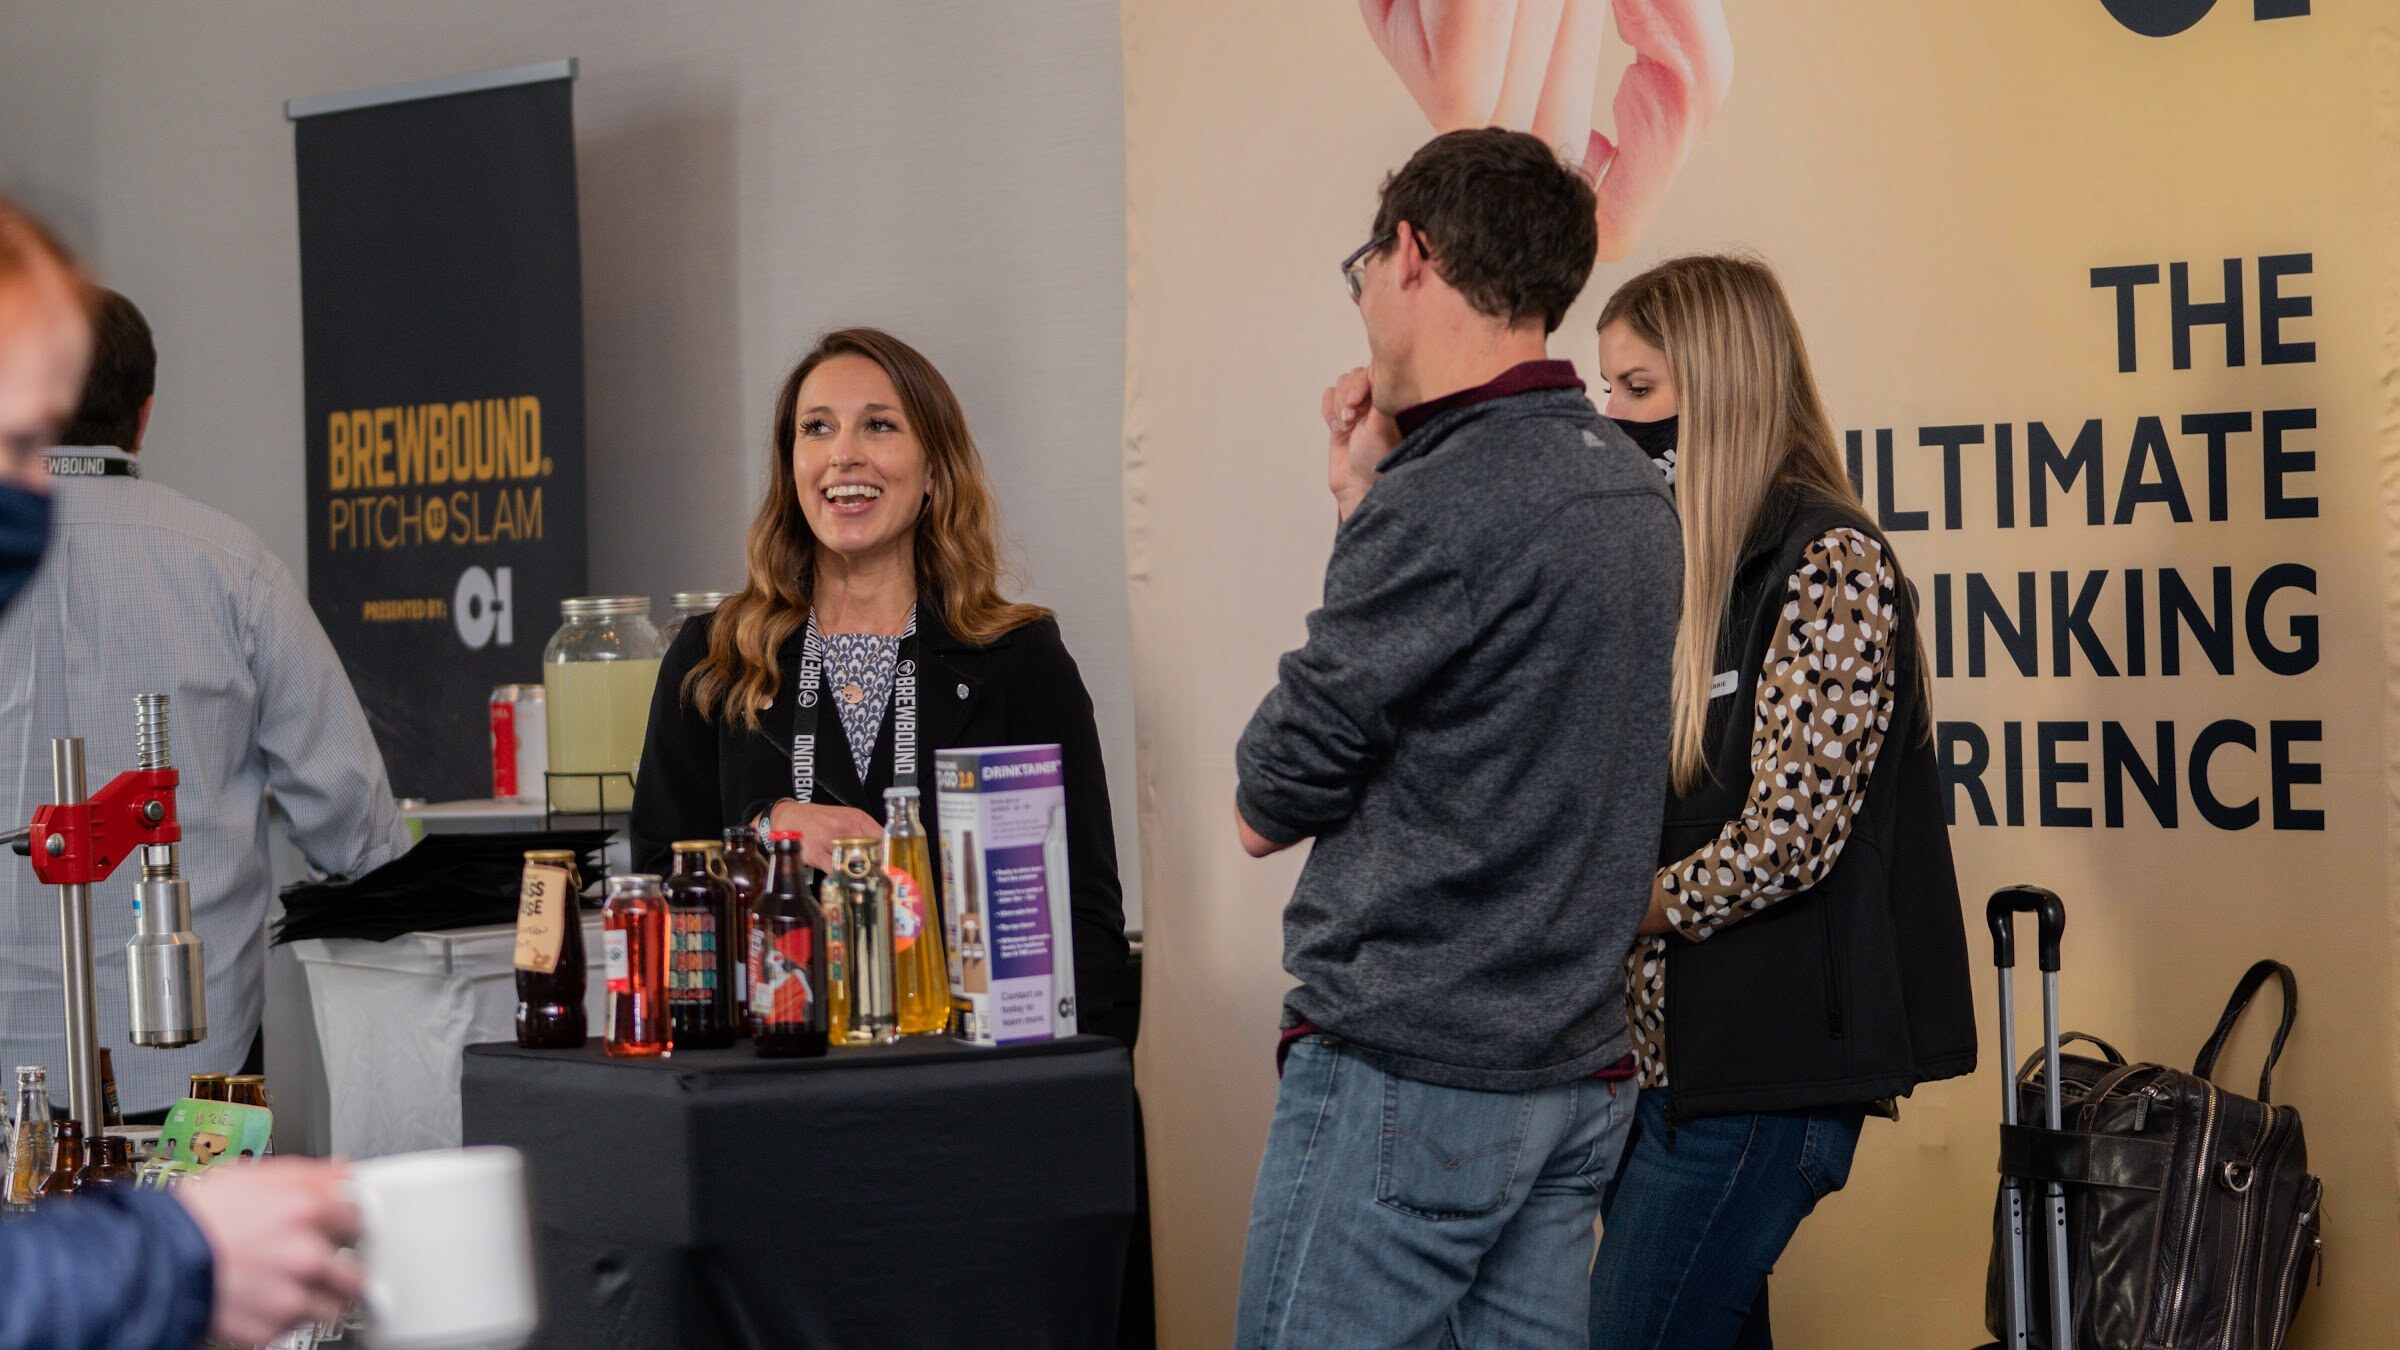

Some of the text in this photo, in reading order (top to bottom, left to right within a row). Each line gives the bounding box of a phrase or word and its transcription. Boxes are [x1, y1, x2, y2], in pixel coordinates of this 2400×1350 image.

[2090, 253, 2316, 373] THE
[39, 456, 105, 475] EWBOUND
[329, 494, 422, 550] PITCH
[451, 486, 543, 545] SLAM
[363, 600, 425, 621] PRESENTED
[1905, 562, 2320, 677] INKING
[894, 676, 916, 774] BREWBOUND
[794, 734, 815, 803] WBOUND
[1937, 719, 2325, 830] RIENCE
